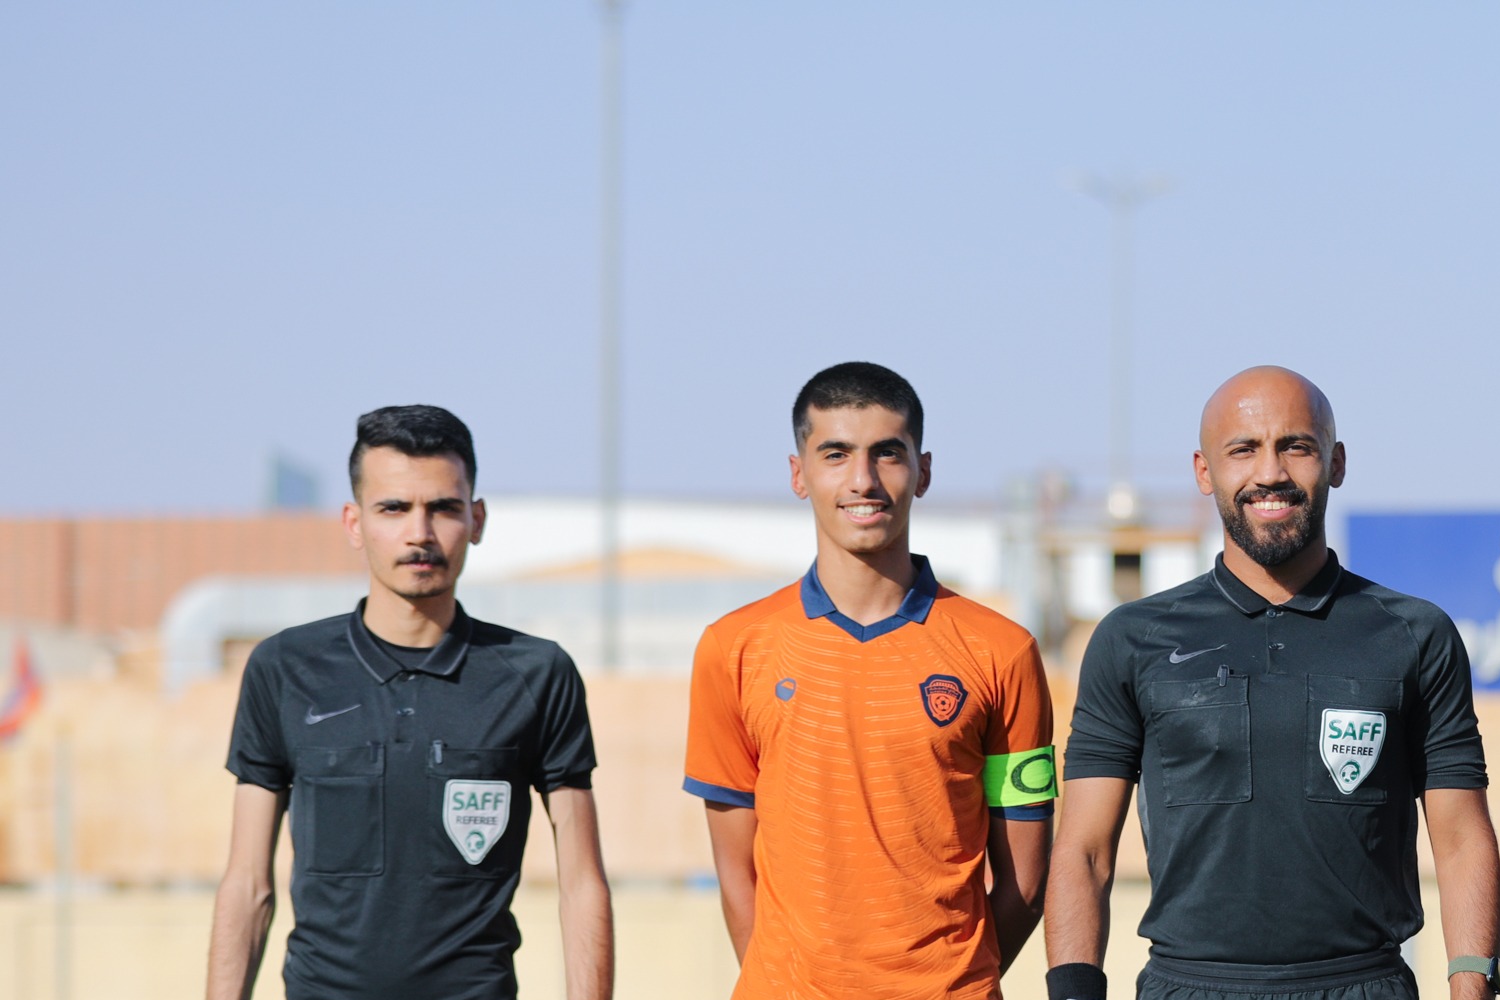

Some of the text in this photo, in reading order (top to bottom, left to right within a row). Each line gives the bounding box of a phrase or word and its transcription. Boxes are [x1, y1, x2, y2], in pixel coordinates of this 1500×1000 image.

[1328, 719, 1382, 741] SAFF
[1332, 744, 1374, 756] REFEREE
[452, 791, 505, 811] SAFF
[456, 816, 498, 826] REFEREE
